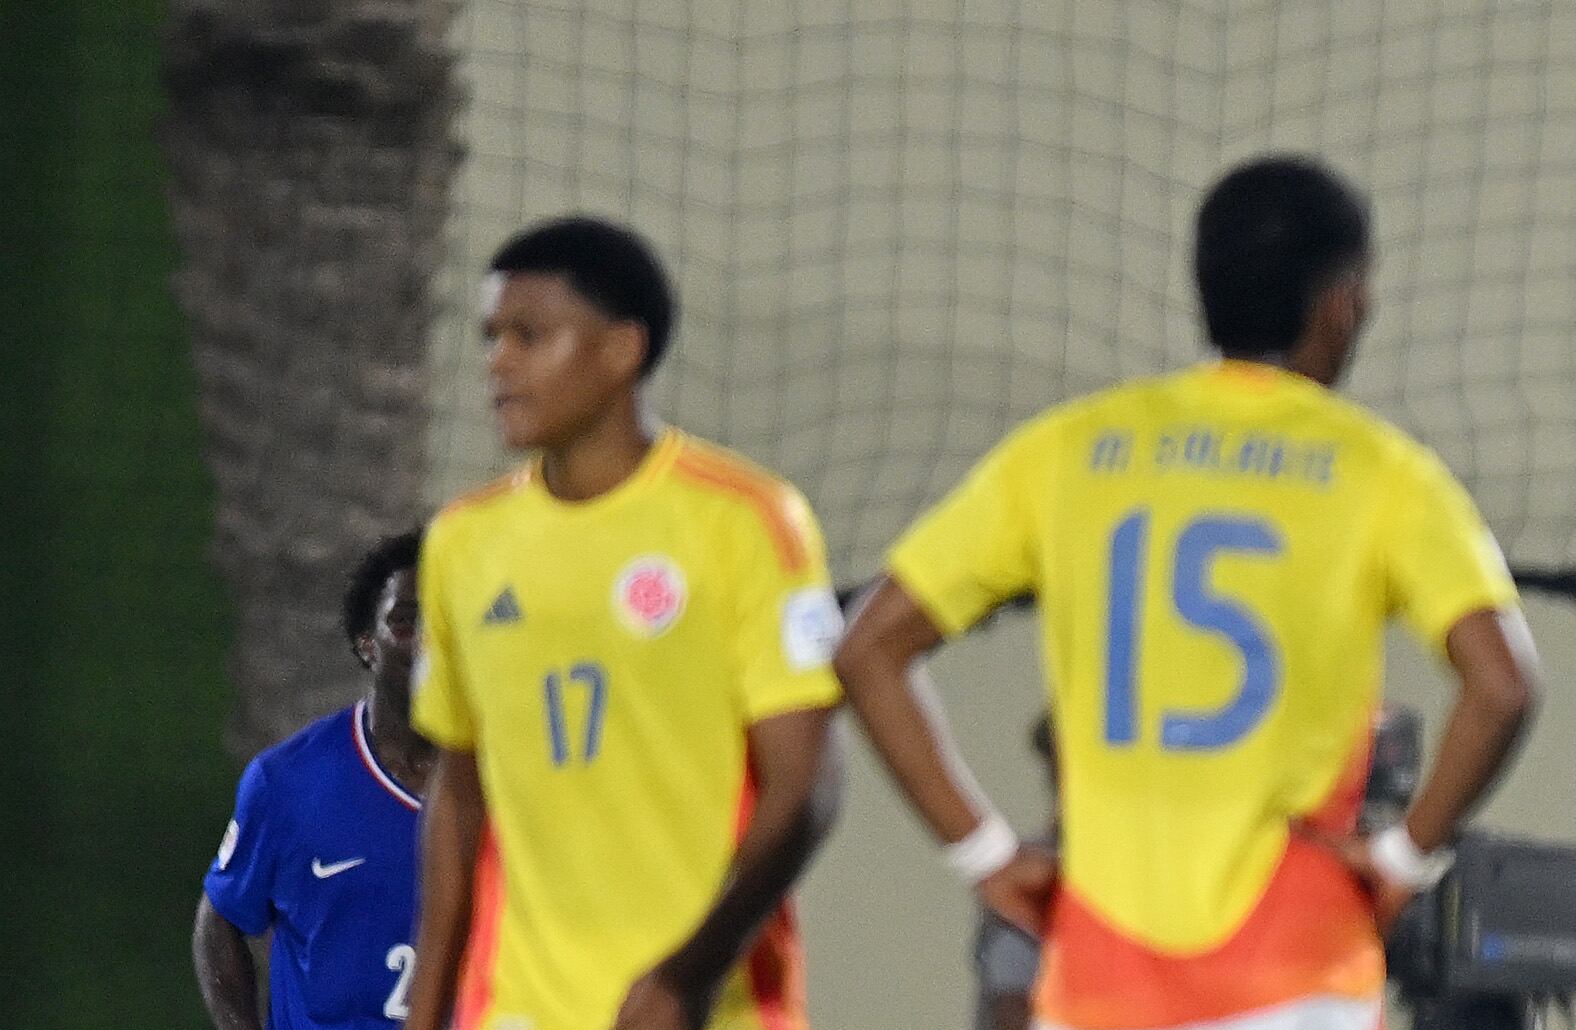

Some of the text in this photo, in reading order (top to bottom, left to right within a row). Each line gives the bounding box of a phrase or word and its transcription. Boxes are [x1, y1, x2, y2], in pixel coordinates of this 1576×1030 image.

[1102, 508, 1284, 752] 15
[543, 662, 609, 764] 17
[383, 943, 417, 1020] 2
